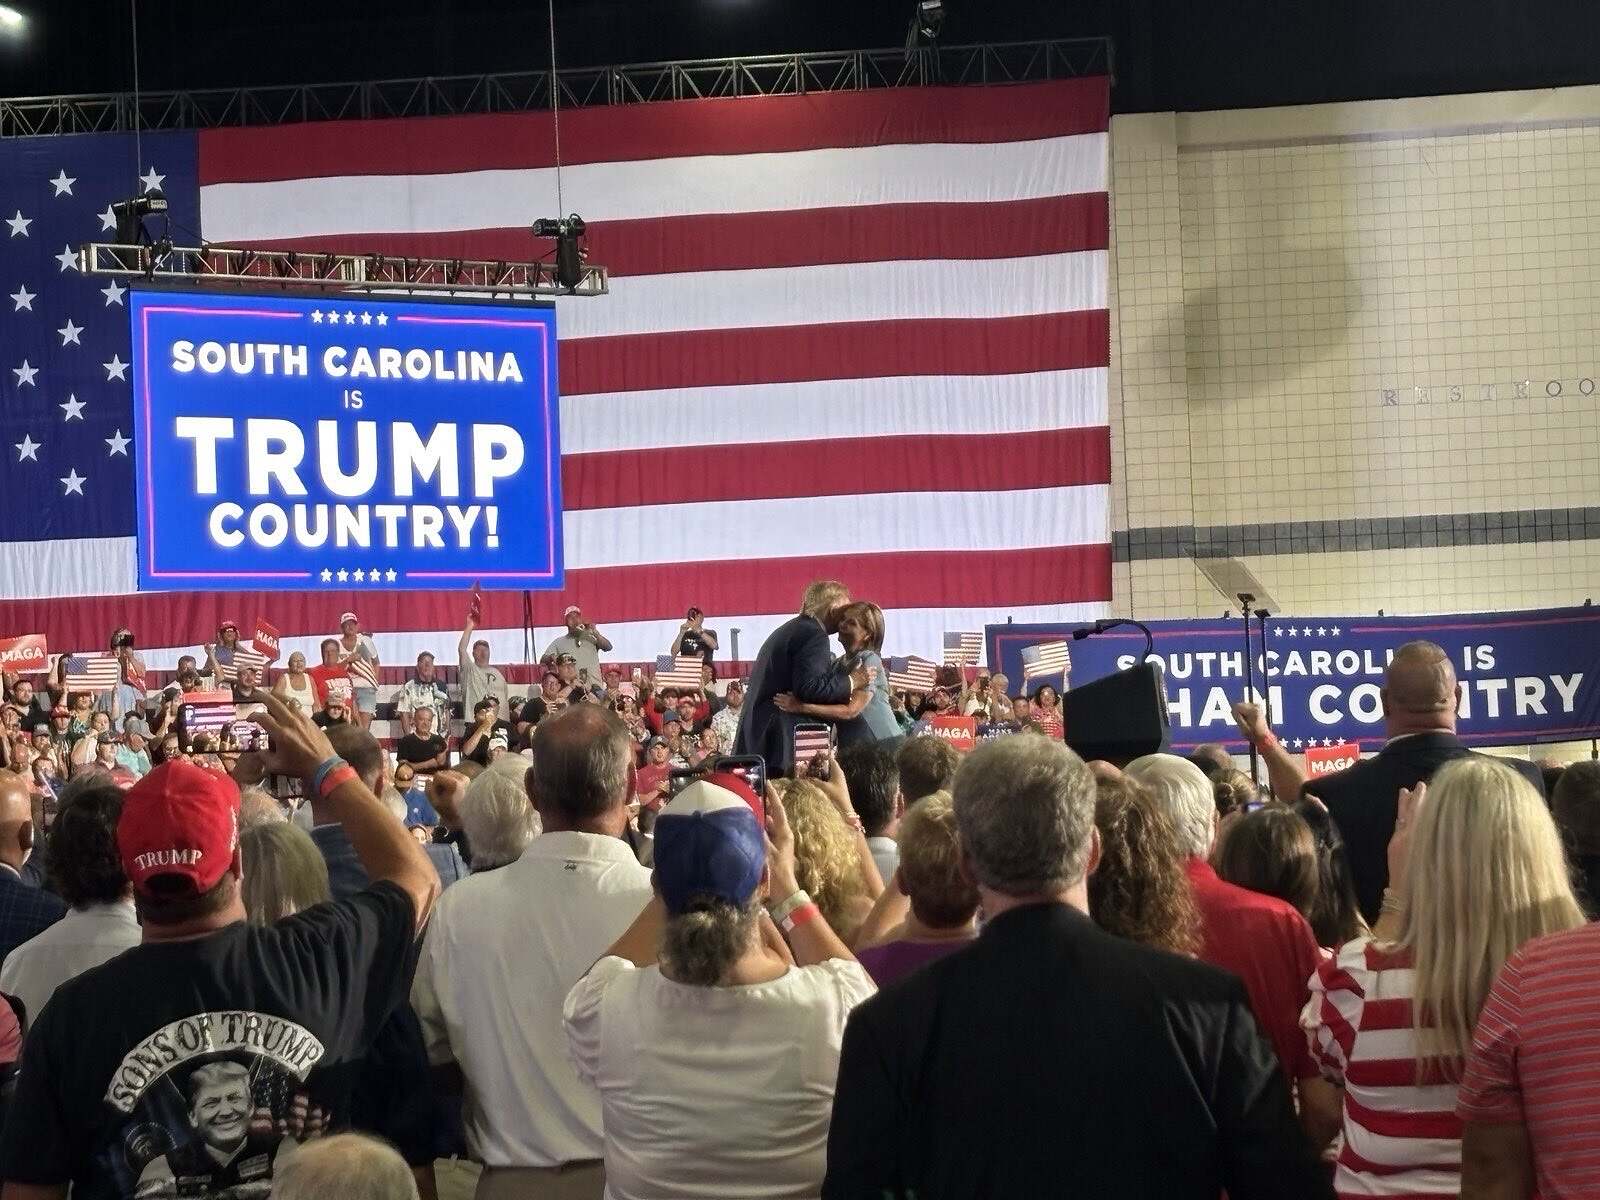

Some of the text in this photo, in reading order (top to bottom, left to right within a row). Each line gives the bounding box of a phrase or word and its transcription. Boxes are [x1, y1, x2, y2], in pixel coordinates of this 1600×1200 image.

[172, 340, 523, 383] SOUTH CAROLINA
[344, 389, 364, 409] IS
[175, 416, 525, 498] TRUMP
[208, 502, 500, 548] COUNTRY!
[0, 646, 44, 662] MAGA
[255, 629, 279, 651] MAGA
[1258, 649, 1394, 676] CAROLI
[1463, 644, 1495, 671] IS
[134, 849, 203, 872] TRUMP
[113, 1012, 320, 1107] SONS OF TRUMP
